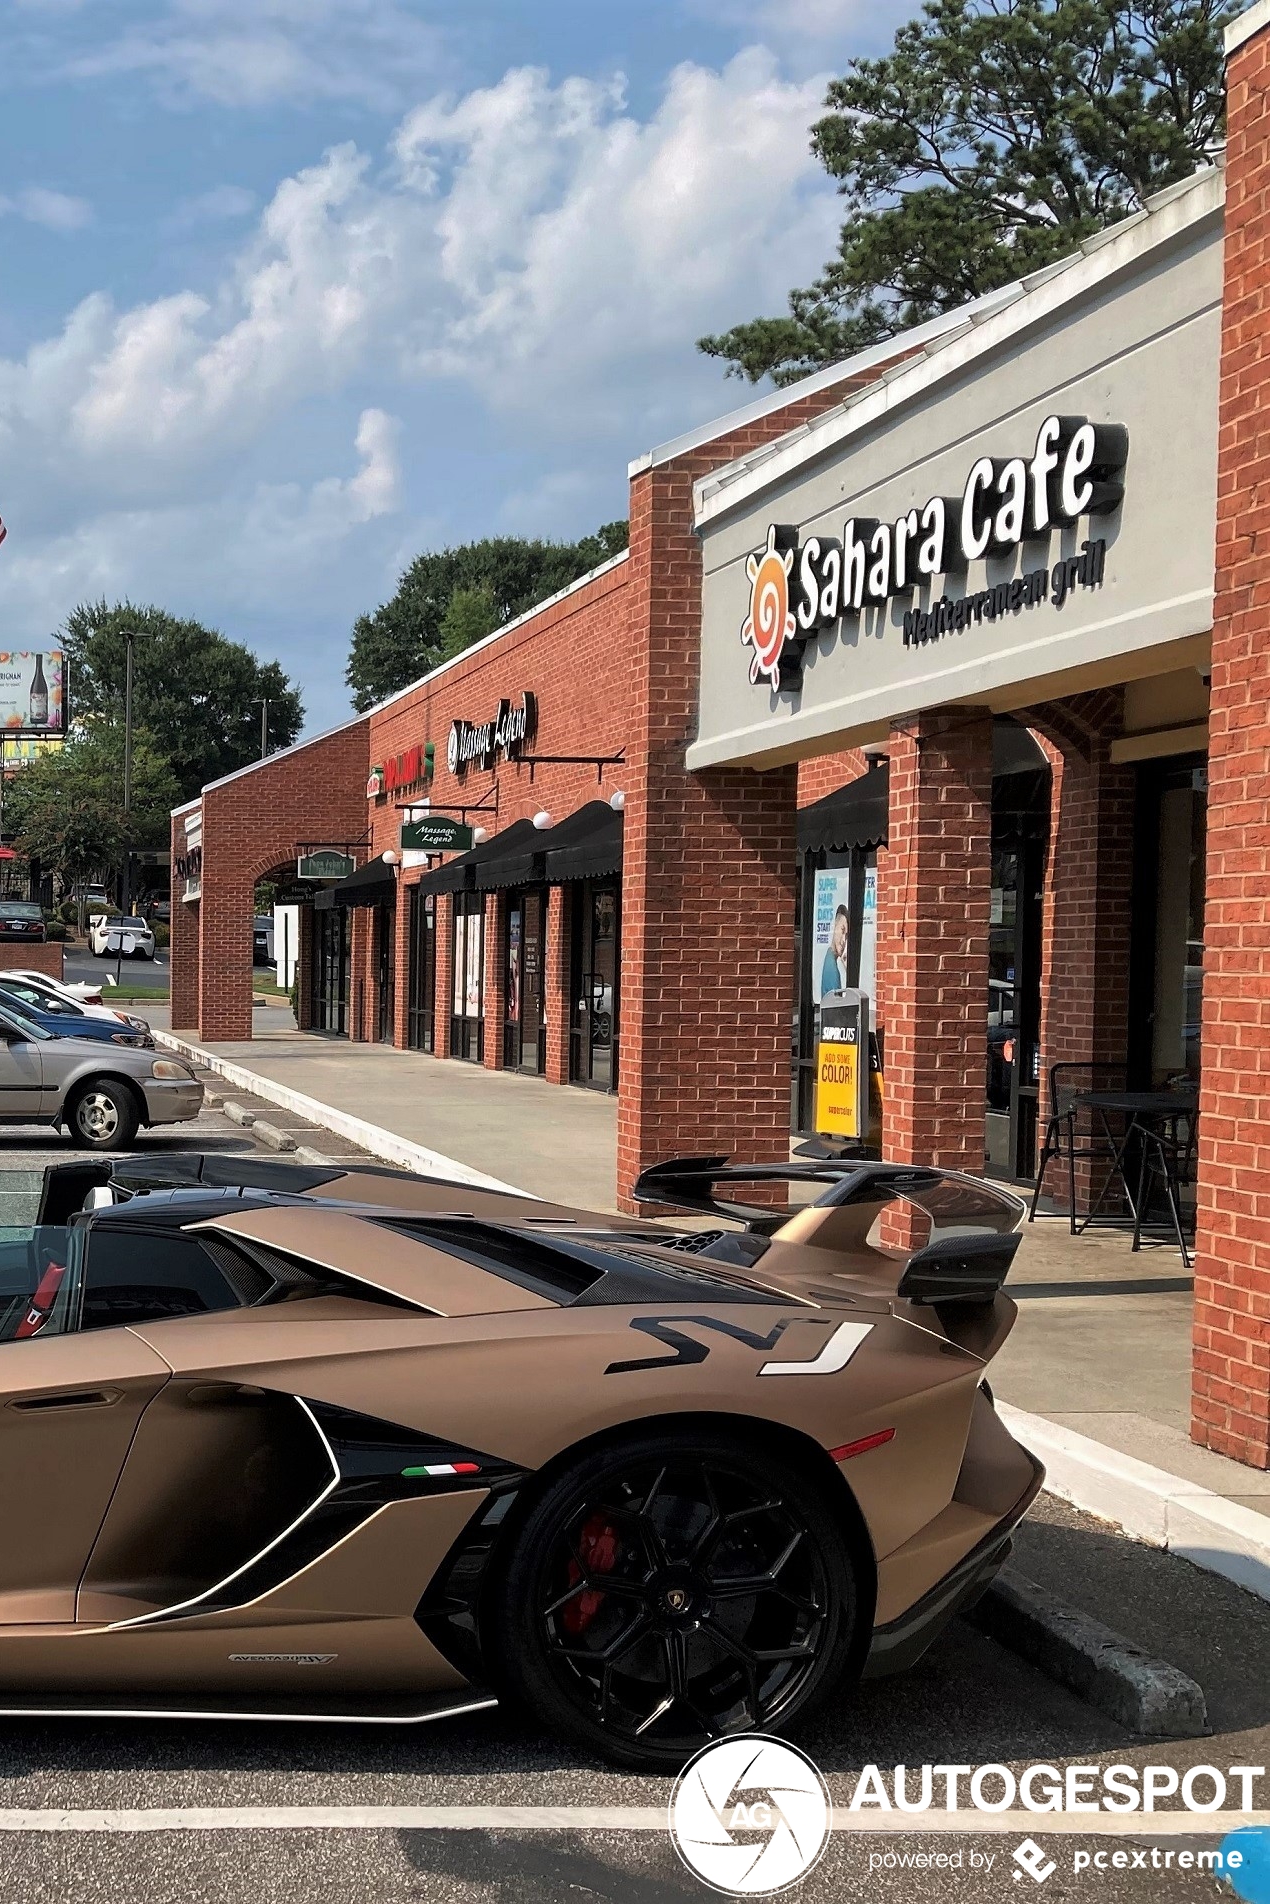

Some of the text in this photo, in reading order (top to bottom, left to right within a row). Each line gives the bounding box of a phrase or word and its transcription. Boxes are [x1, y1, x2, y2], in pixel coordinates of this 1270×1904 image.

[798, 414, 1100, 630] Sahara Cafe
[902, 538, 1106, 646] Mediterranean grill
[493, 691, 528, 762] Legend
[416, 826, 456, 837] Massage
[421, 834, 453, 845] Legend
[818, 877, 837, 892] SUPER
[818, 892, 834, 907] HAIR
[817, 908, 834, 922] DAYS
[817, 922, 831, 933] START
[825, 1053, 851, 1065] ADD SOME
[821, 1064, 852, 1085] COLOR!
